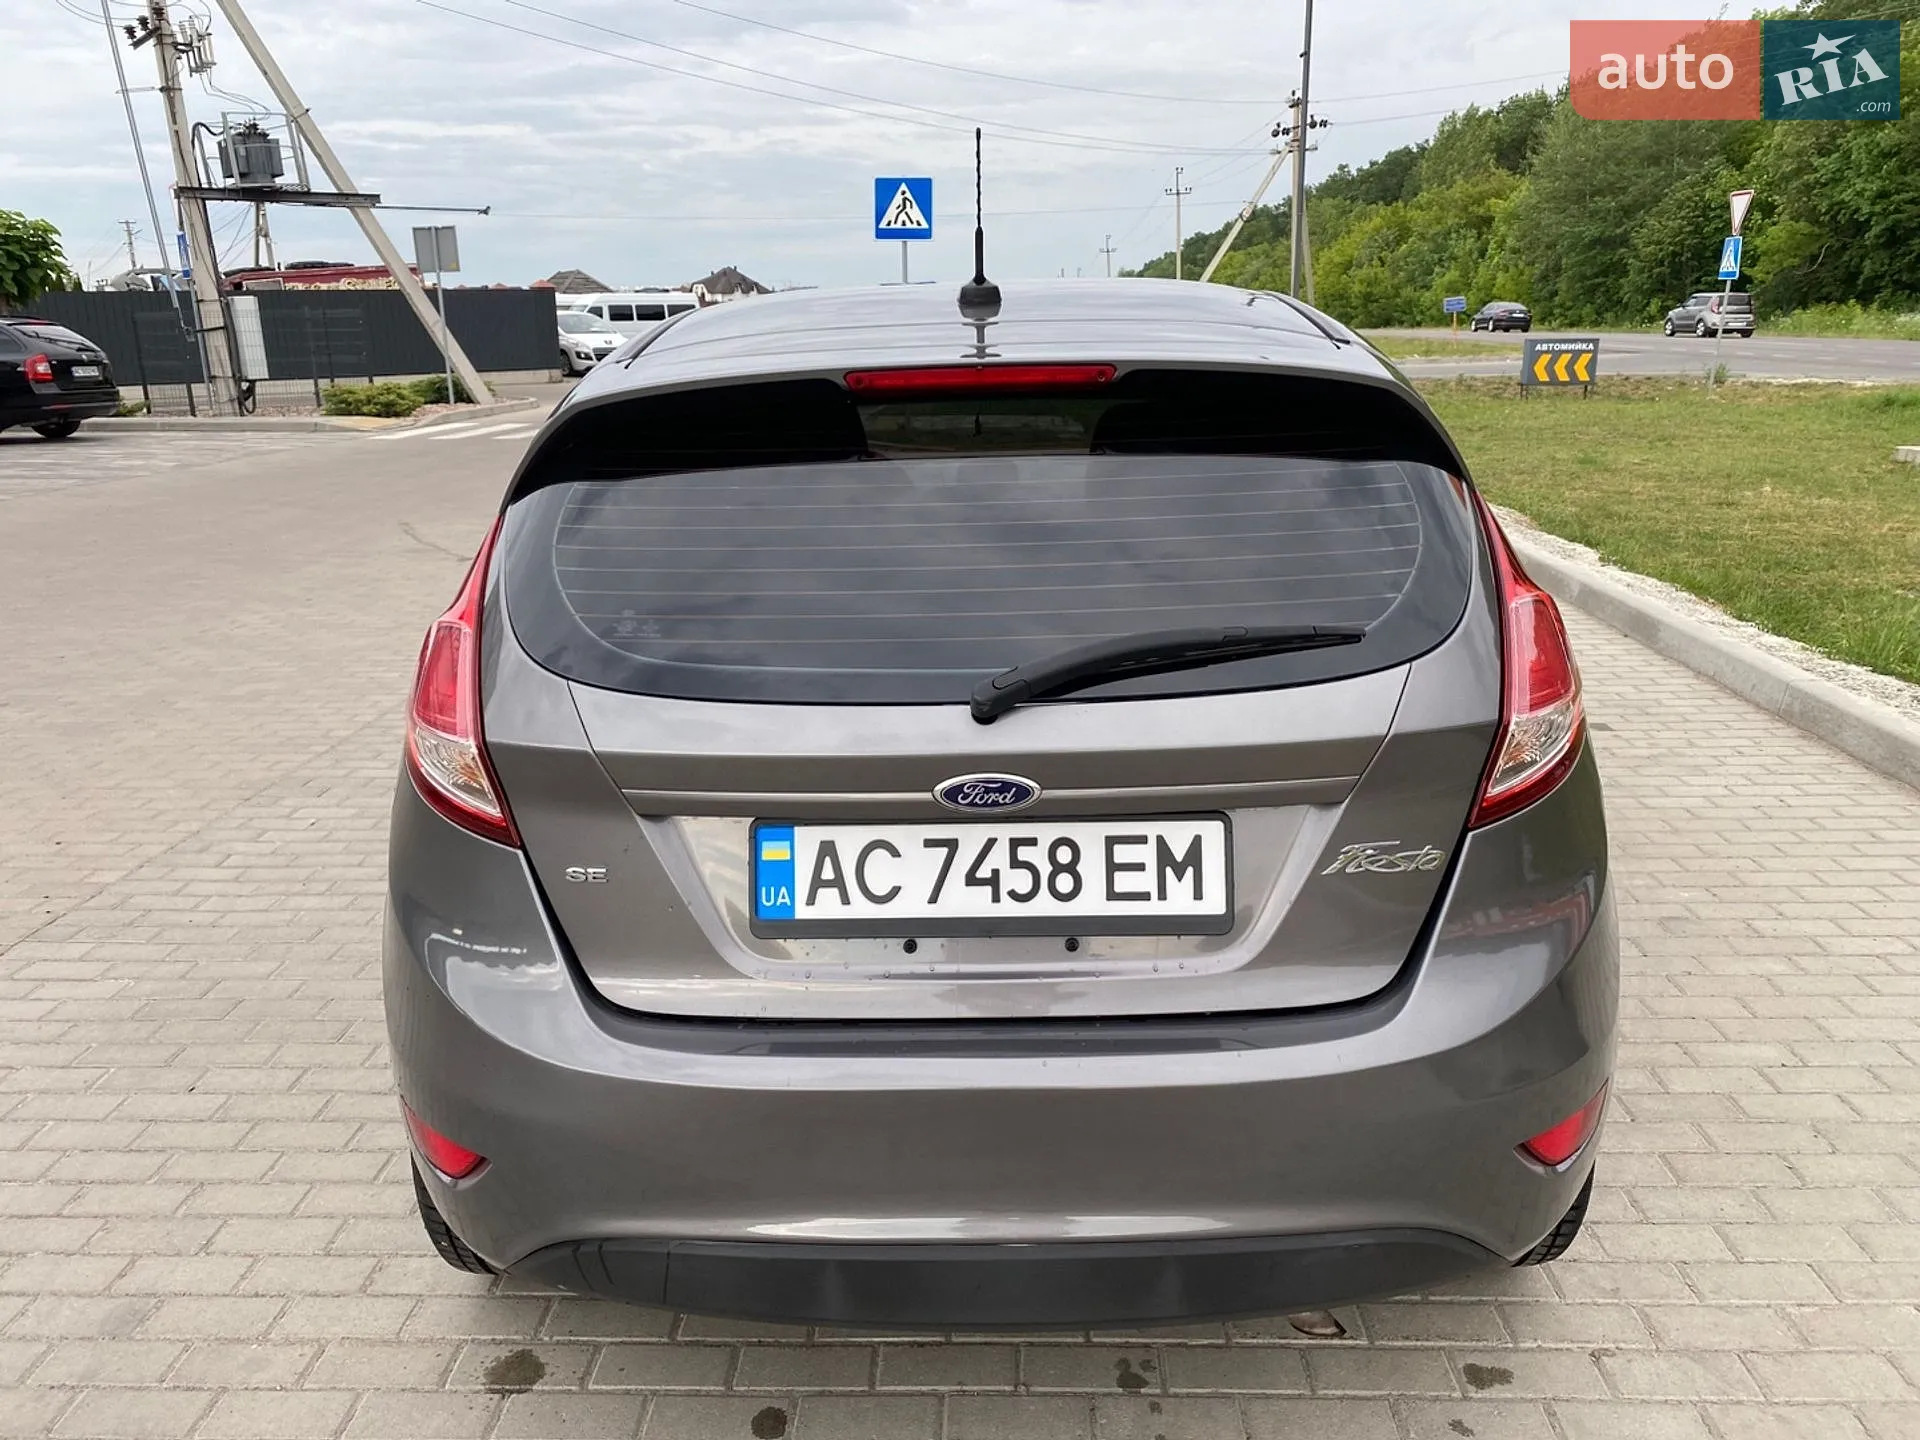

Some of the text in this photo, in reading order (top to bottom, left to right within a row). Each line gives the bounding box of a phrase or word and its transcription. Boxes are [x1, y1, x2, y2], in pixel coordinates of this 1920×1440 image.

[957, 782, 1017, 805] Ford
[565, 867, 607, 883] SE
[805, 834, 1204, 906] AC 7458 EM
[761, 885, 791, 907] UA
